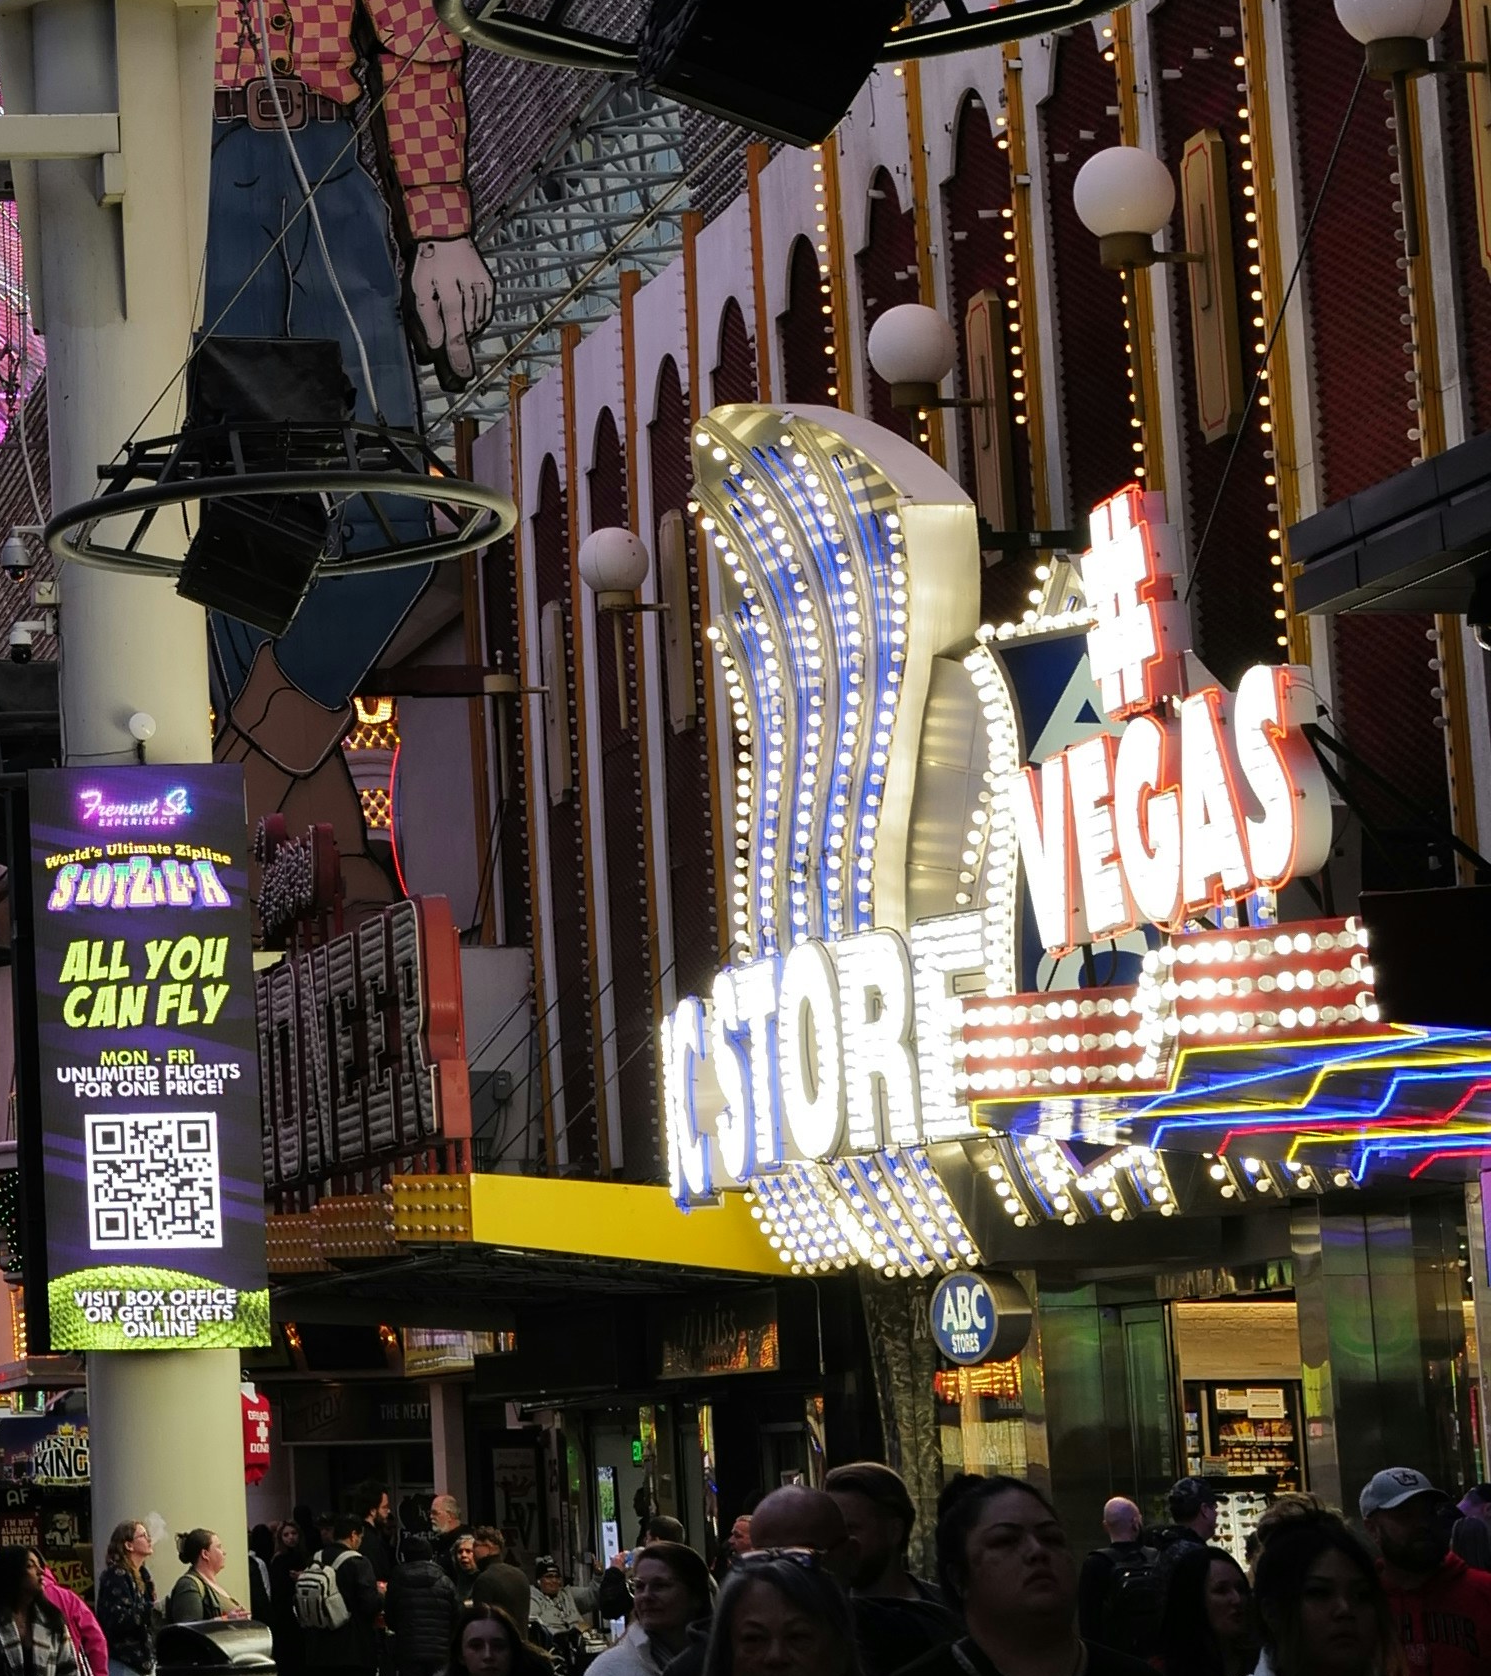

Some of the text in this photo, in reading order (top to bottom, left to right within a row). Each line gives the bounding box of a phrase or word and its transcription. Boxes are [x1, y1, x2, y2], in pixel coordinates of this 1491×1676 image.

[80, 789, 158, 820] Fremont
[1010, 664, 1301, 956] VEGAS
[98, 817, 176, 826] EXPERIENCE
[45, 841, 231, 869] World's Ultimate Zipline
[47, 855, 231, 911] SLOTZILLA
[58, 935, 229, 983] ALL YOU
[63, 983, 230, 1029] CAN FLY
[100, 1050, 148, 1066] MON
[167, 1049, 195, 1064] FRI
[661, 912, 985, 1199] C STORE
[57, 1064, 241, 1083] UNLIMITED FLIGHTS
[74, 1079, 224, 1097] FOR ONE PRICE!
[74, 1289, 237, 1306] VISIT BOX OFFICE
[85, 1305, 233, 1322] OR GET TICKETS
[942, 1283, 987, 1332] ABC
[123, 1321, 197, 1337] ONLINE
[951, 1333, 980, 1354] STORES
[380, 1402, 430, 1421] THE NEXT
[6, 1488, 30, 1507] AF
[1, 1528, 31, 1536] ALWAYS
[2, 1535, 39, 1546] BITCH
